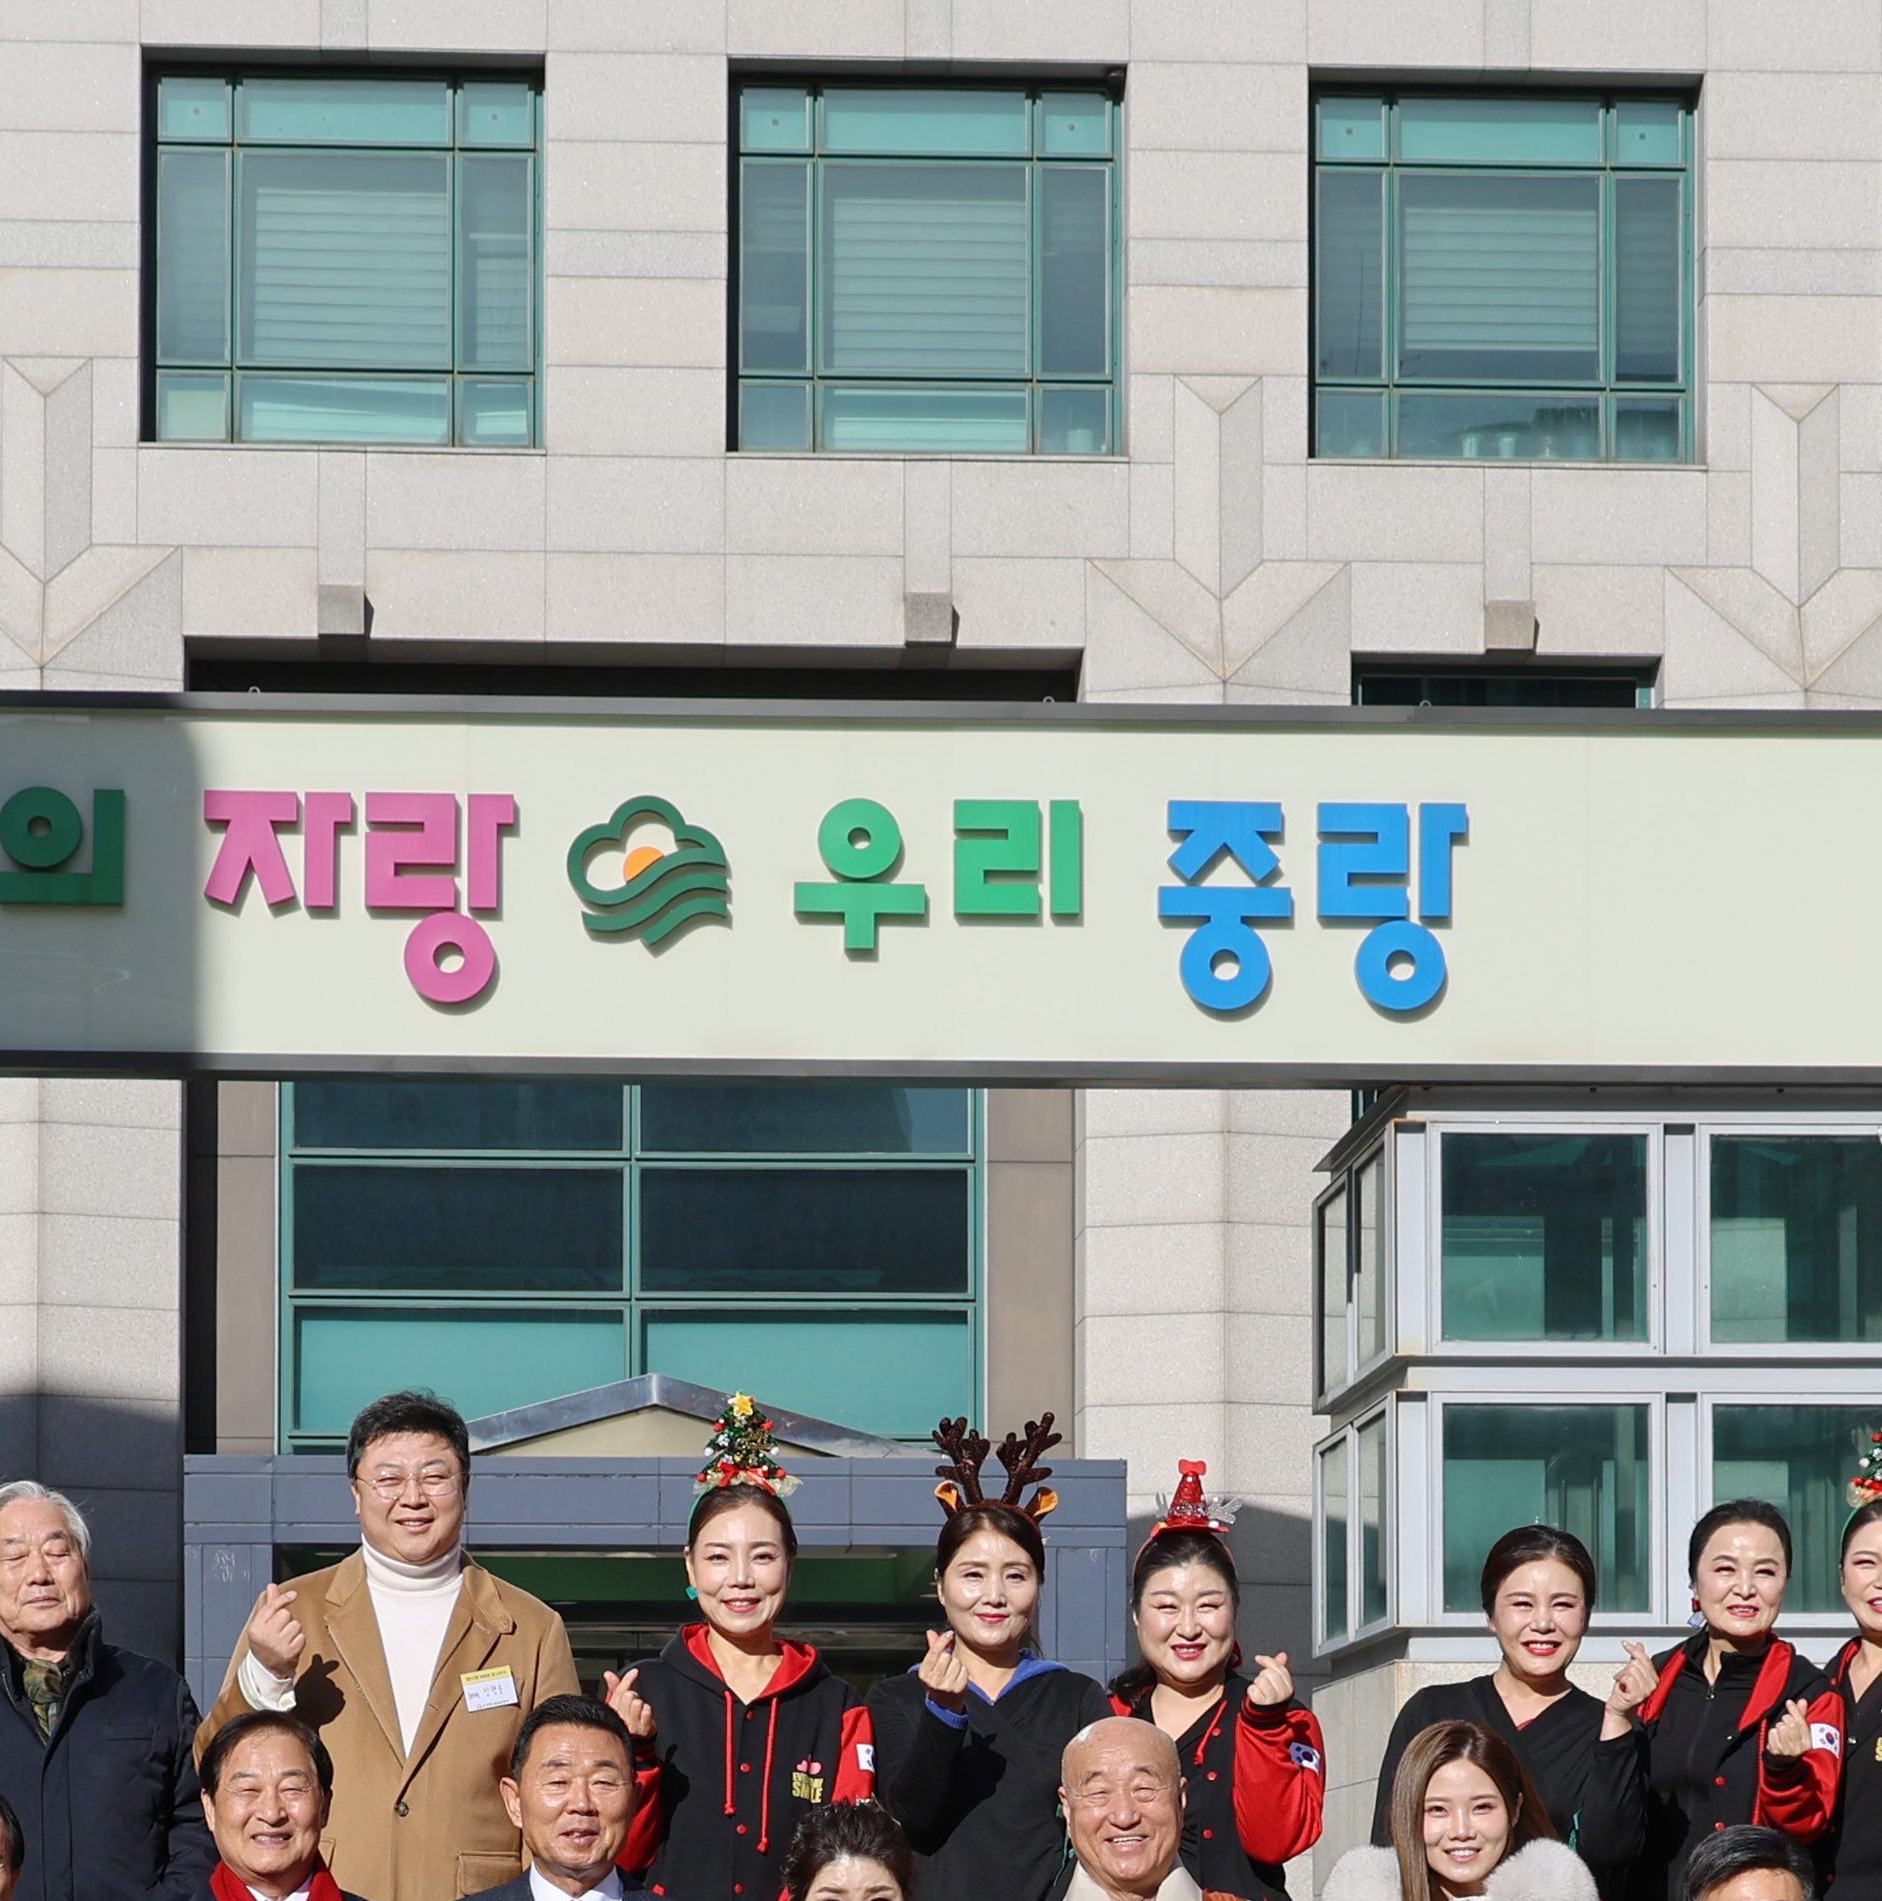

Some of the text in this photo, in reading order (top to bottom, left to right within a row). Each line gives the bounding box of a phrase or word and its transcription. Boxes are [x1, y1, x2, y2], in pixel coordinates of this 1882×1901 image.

[203, 790, 518, 1012] 자랑
[793, 797, 1082, 961] 우리
[1154, 801, 1470, 1017] 중랑
